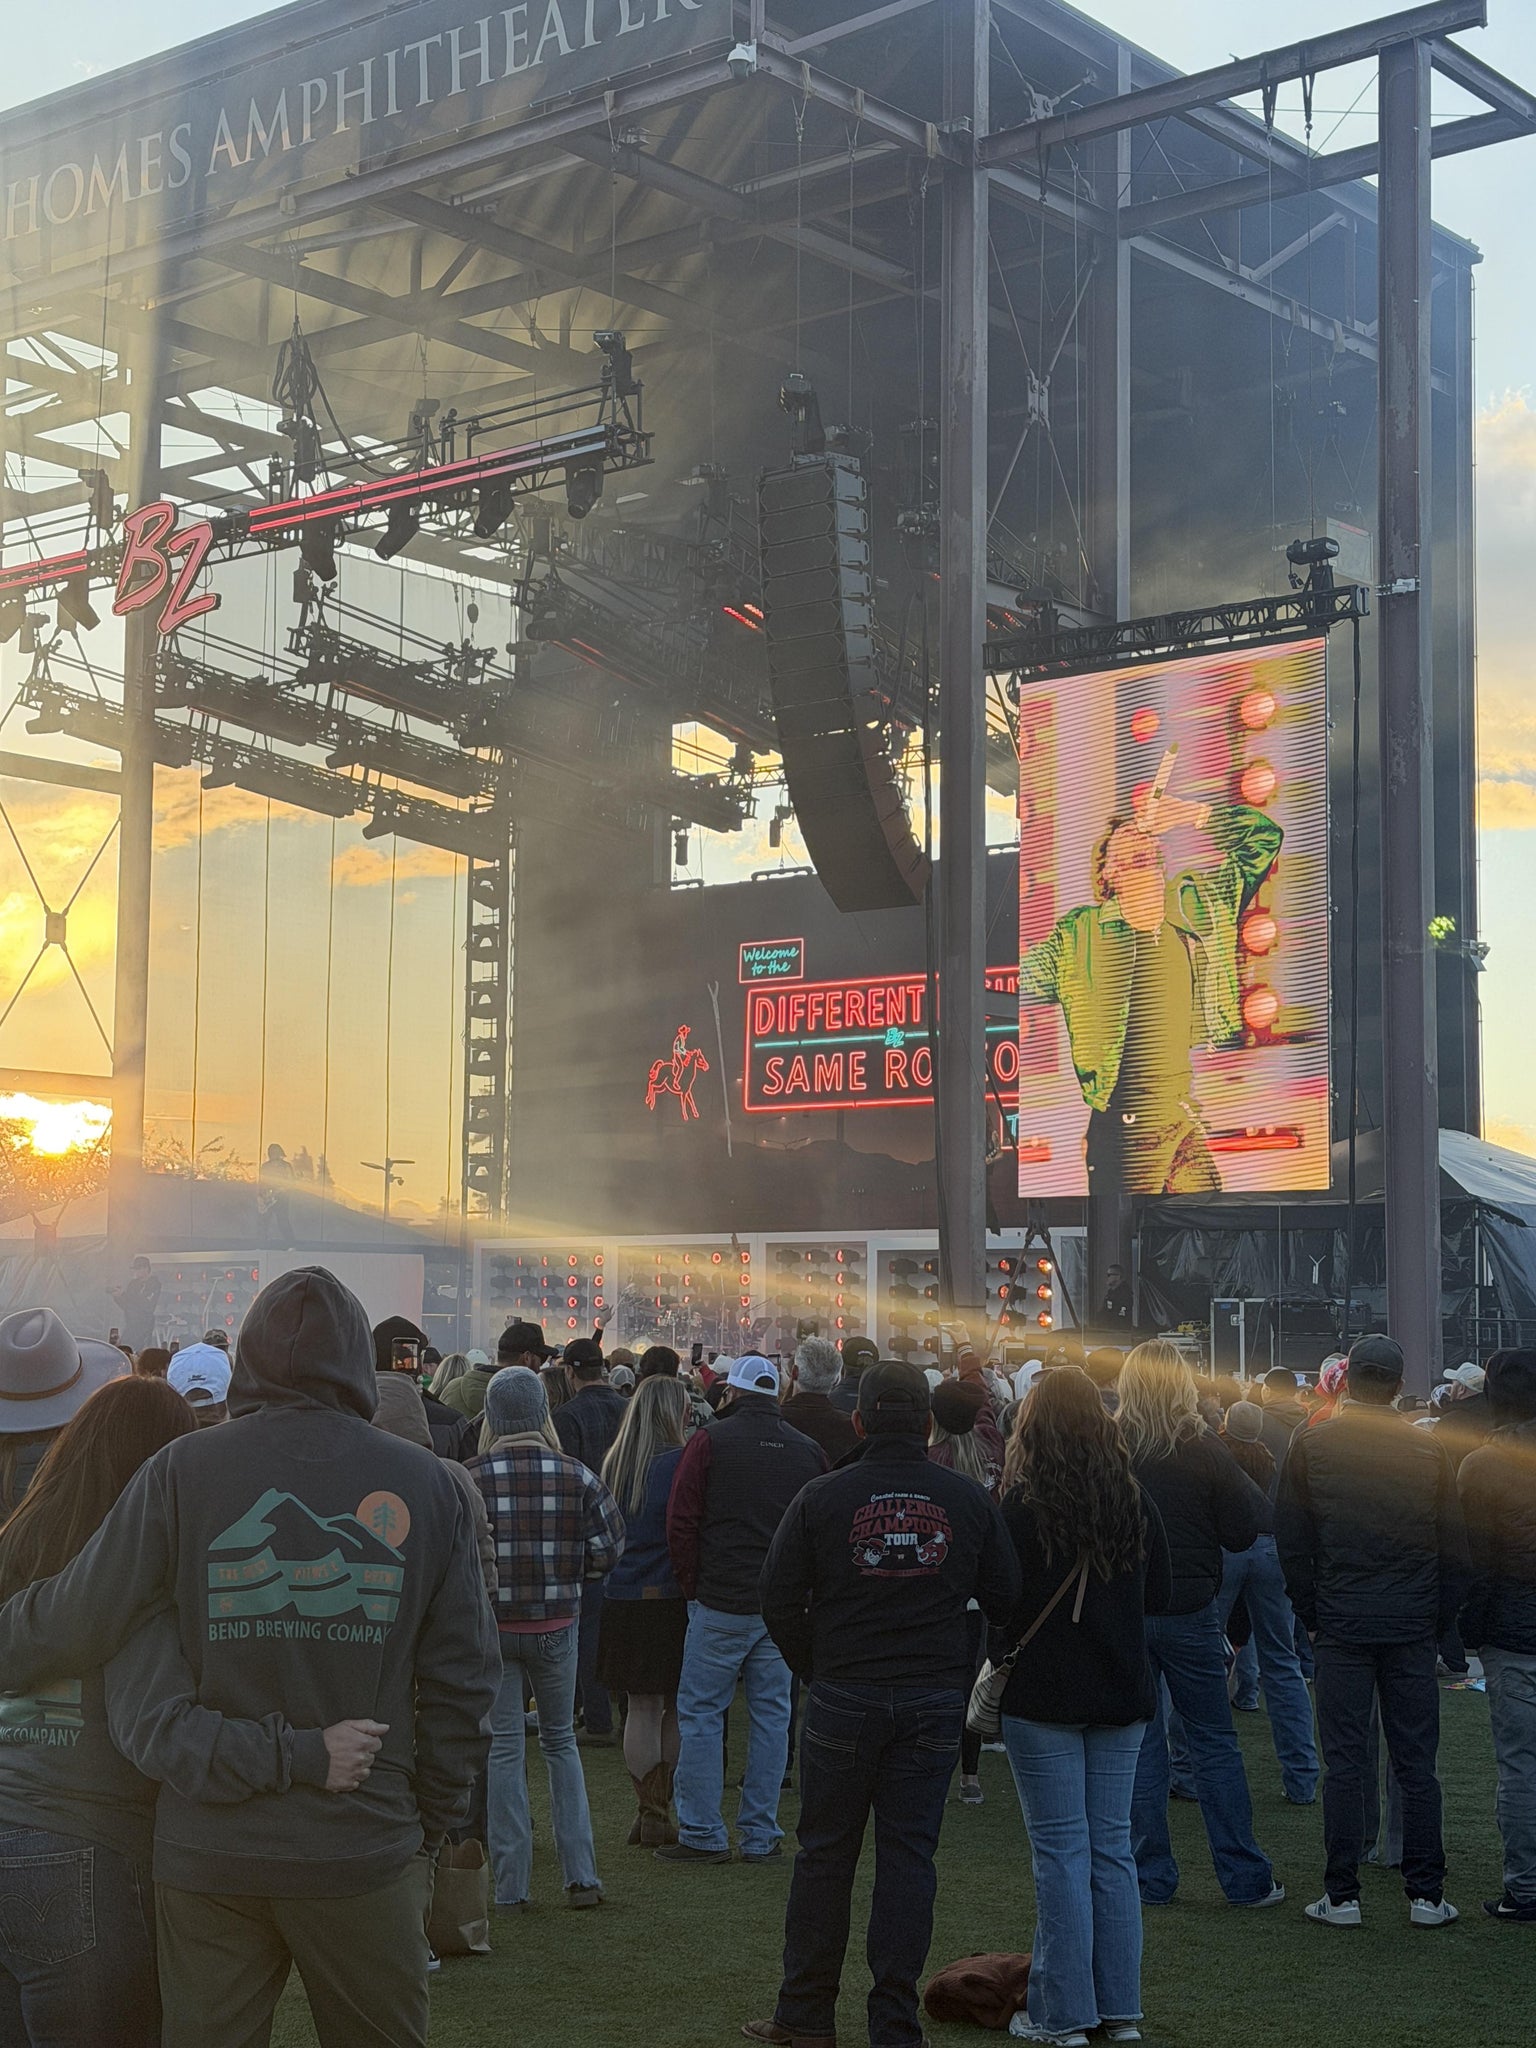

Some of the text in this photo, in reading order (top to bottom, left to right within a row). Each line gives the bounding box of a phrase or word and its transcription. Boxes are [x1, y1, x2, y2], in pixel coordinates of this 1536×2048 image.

[3, 122, 192, 241] HOMES
[113, 503, 219, 633] BZ
[744, 946, 800, 963] Welcome
[751, 960, 791, 975] to the
[755, 985, 926, 1035] DIFFERENT
[762, 1041, 1019, 1095] SAME ROO
[853, 1498, 948, 1525] CHALLENGE
[895, 1509, 906, 1521] of
[849, 1516, 953, 1543] CHAMPIONS
[884, 1533, 918, 1546] TOUR
[208, 1622, 250, 1641] BEND
[256, 1620, 321, 1640] BREWING
[14, 1728, 80, 1746] COMPANY
